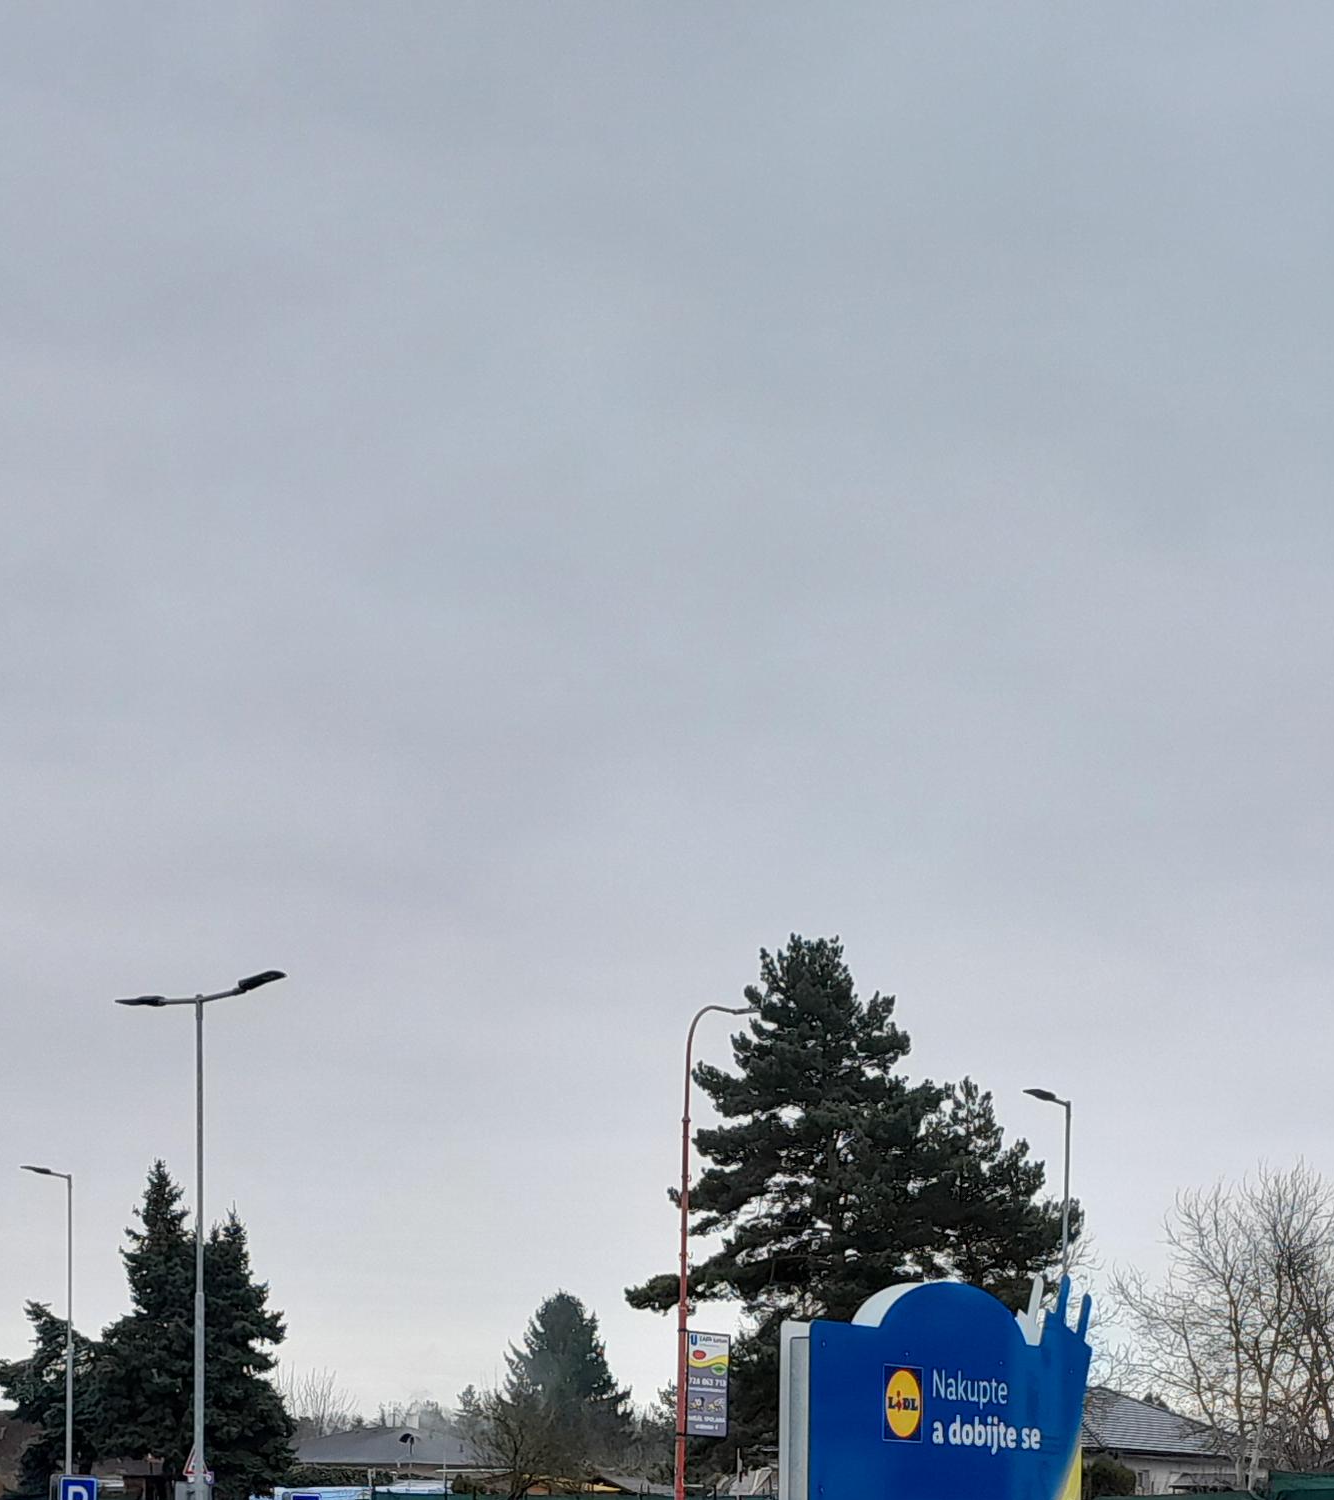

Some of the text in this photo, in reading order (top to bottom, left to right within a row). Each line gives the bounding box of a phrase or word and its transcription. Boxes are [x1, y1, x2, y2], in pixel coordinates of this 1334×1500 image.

[932, 1368, 1008, 1410] Nakupte
[932, 1414, 1041, 1455] a dobijte se
